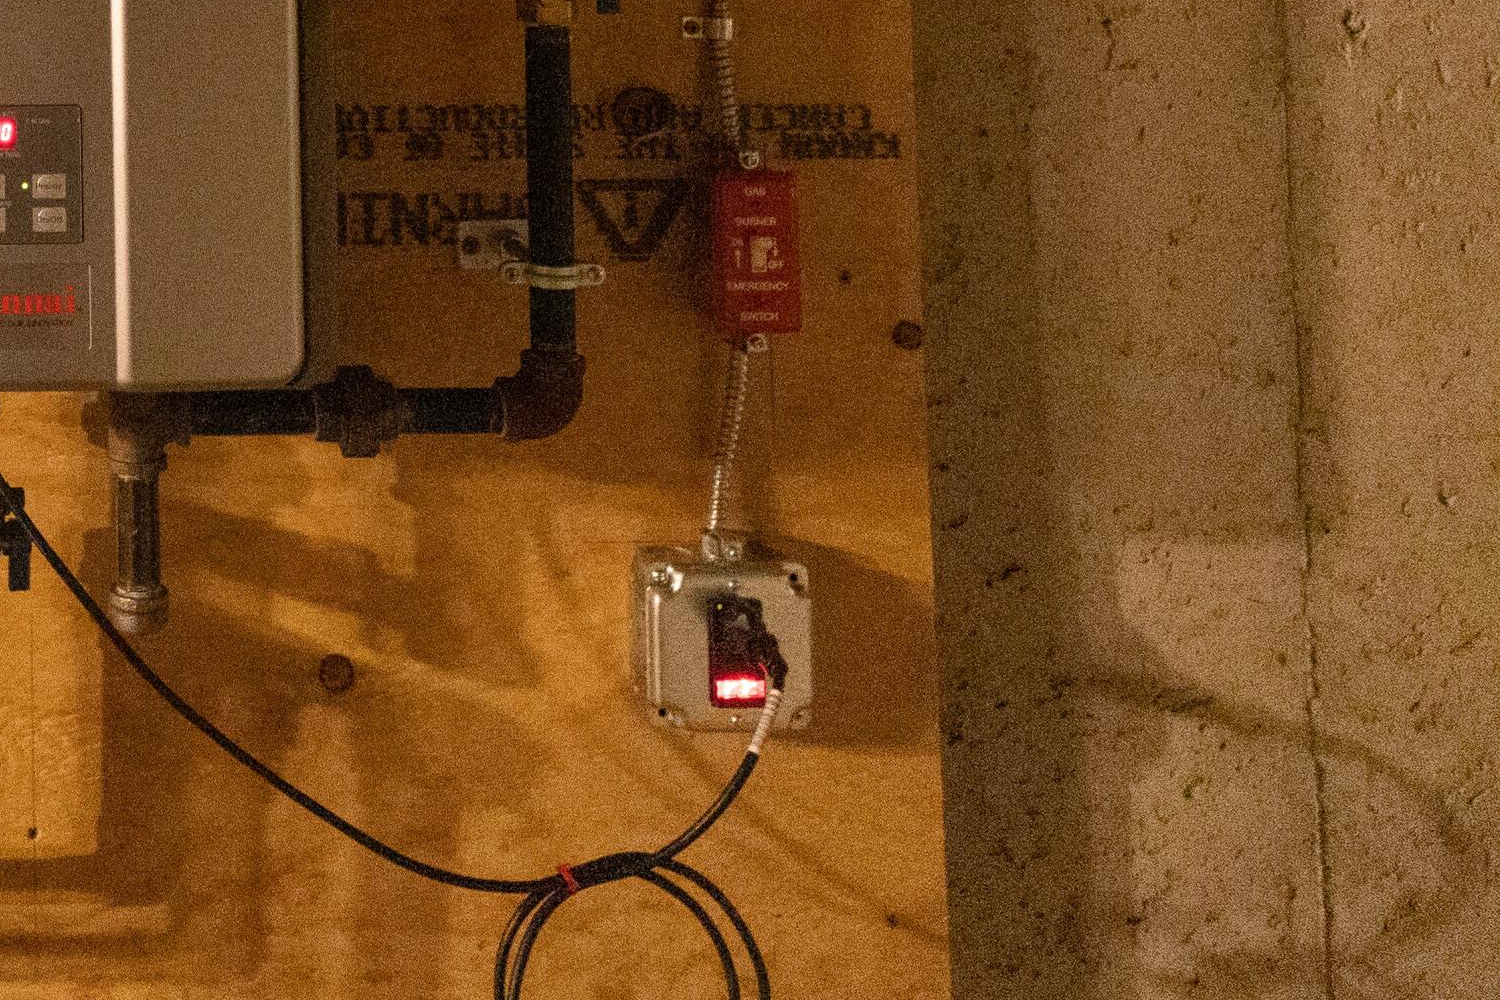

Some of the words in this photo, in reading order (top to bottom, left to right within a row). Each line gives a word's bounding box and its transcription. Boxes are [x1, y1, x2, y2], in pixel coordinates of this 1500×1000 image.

[734, 216, 777, 226] BURNER
[726, 281, 789, 291] EMERGENCY
[740, 312, 779, 321] SWITCH
